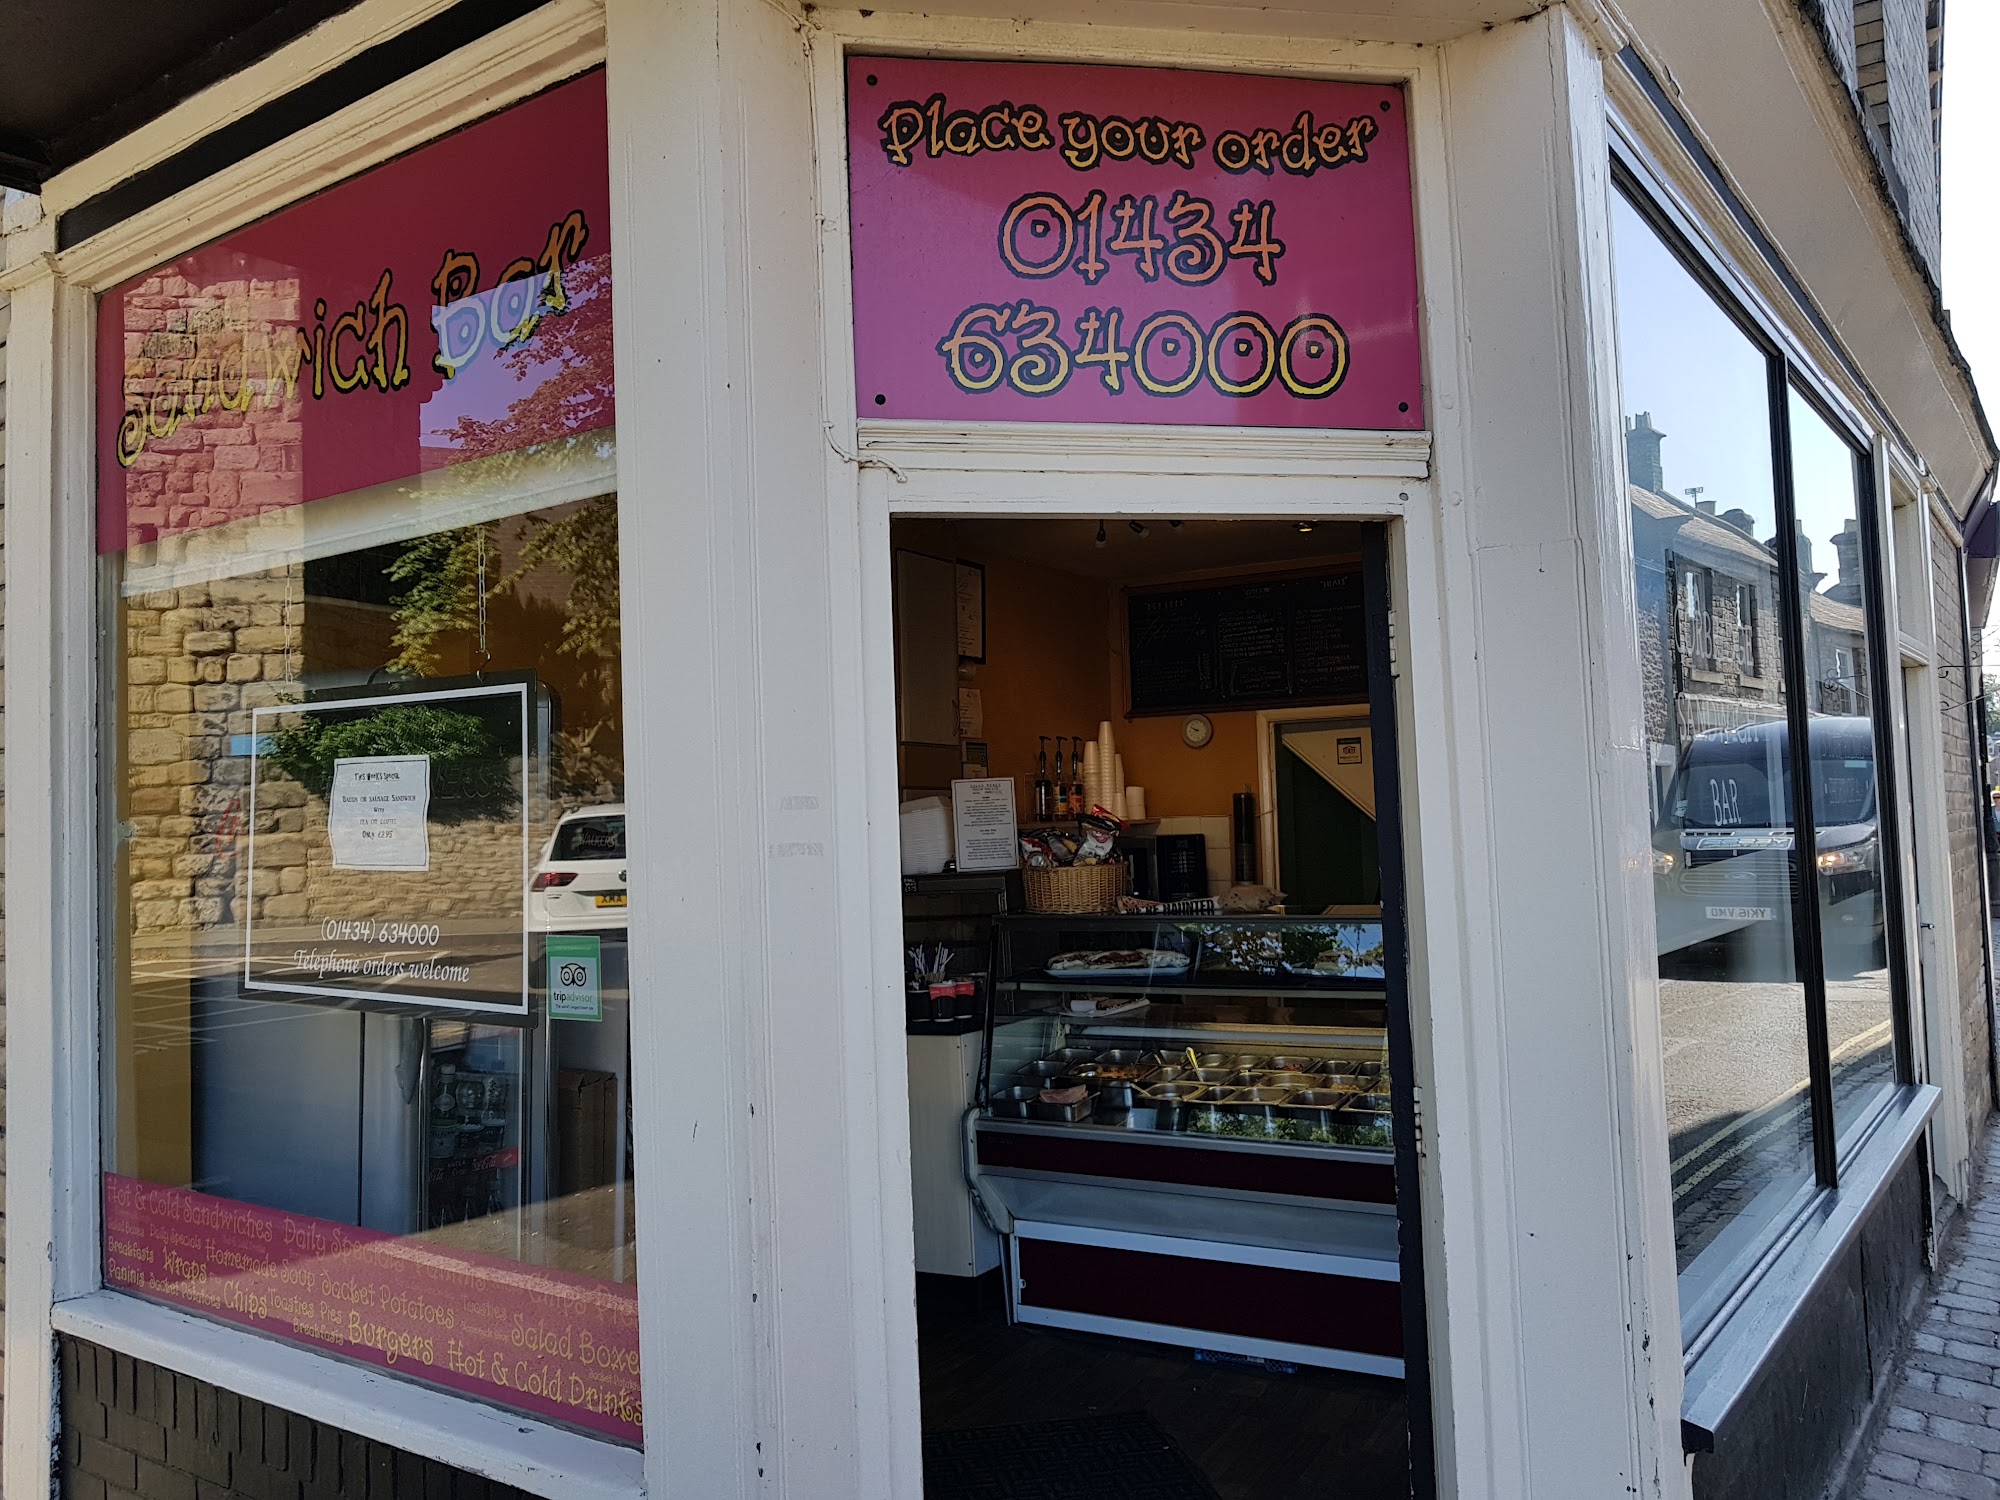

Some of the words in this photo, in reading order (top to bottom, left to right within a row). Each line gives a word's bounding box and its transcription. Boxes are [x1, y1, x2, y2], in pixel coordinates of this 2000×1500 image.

[878, 93, 1056, 168] Place
[1059, 110, 1207, 171] your
[1212, 109, 1380, 177] order
[998, 189, 1285, 287] 01434
[117, 268, 411, 468] Sandwich
[432, 209, 590, 385] Bar
[936, 299, 1351, 399] 634000
[1709, 778, 1742, 827] BAR
[293, 948, 360, 980] Telephone
[363, 954, 405, 978] orders
[408, 957, 470, 983] welcome
[320, 916, 376, 943] (01434)
[378, 921, 440, 947] 634000
[553, 991, 593, 1004] tripadvisor
[106, 1176, 131, 1207] Hot
[135, 1184, 147, 1211] &
[149, 1190, 181, 1221] Cold
[183, 1195, 273, 1243] Sandwiches
[283, 1217, 326, 1261] Daily
[331, 1227, 405, 1274] Specials
[108, 1257, 145, 1288] Paninis
[205, 1237, 278, 1279] Homemade
[281, 1258, 316, 1293] Soup
[320, 1268, 376, 1307] Jacket
[379, 1284, 455, 1330] Potatoes
[512, 1312, 573, 1361] Salad
[580, 1328, 639, 1375] Boxe
[108, 1235, 155, 1264] Breakfasts
[162, 1245, 208, 1284] Wraps
[223, 1280, 268, 1321] Chips
[267, 1286, 314, 1319] Toasties
[319, 1301, 343, 1325] Pies
[348, 1308, 434, 1365] Burgers
[448, 1335, 485, 1379] Hot
[491, 1351, 509, 1386] &
[514, 1360, 563, 1404] Cold
[568, 1371, 642, 1427] Drinks
